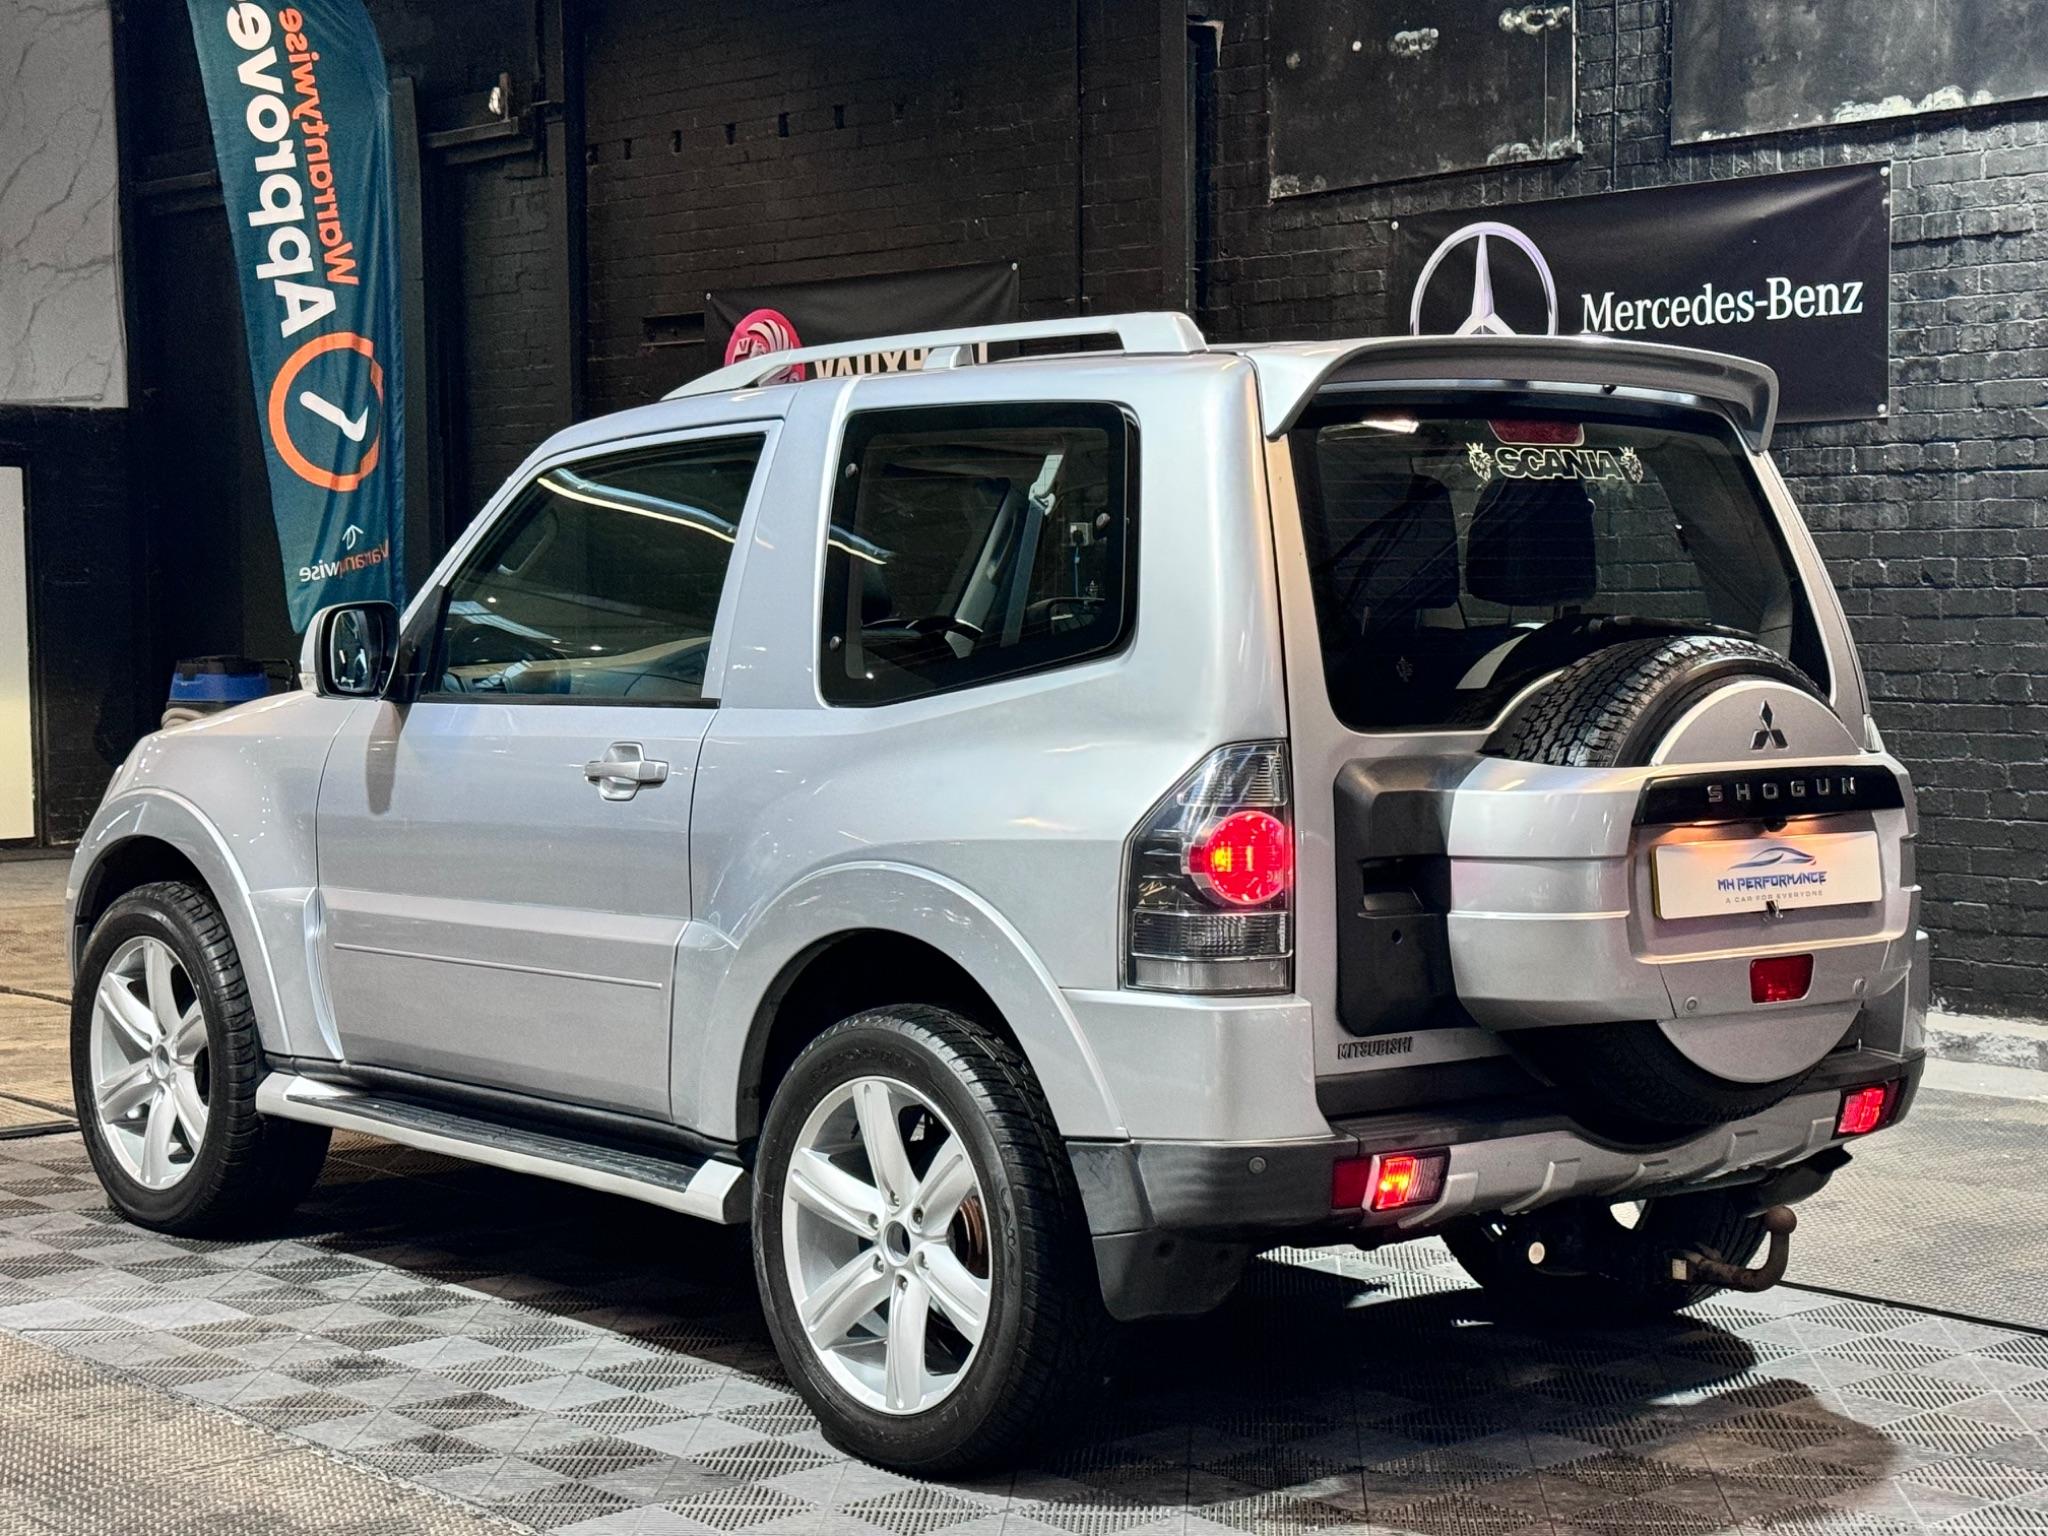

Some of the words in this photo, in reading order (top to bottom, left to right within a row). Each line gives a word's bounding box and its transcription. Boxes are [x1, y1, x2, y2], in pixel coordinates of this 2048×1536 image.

[1581, 276, 1864, 334] Mercedes-Benz
[814, 341, 988, 379] VAUXH
[1495, 447, 1625, 480] SCANIA
[1706, 776, 1856, 803] SHOGUN
[1717, 878, 1735, 891] MH
[1736, 871, 1827, 892] PERFORMANCE
[1776, 889, 1823, 900] EVERYONE
[1337, 1036, 1413, 1060] MITSUBISHI
